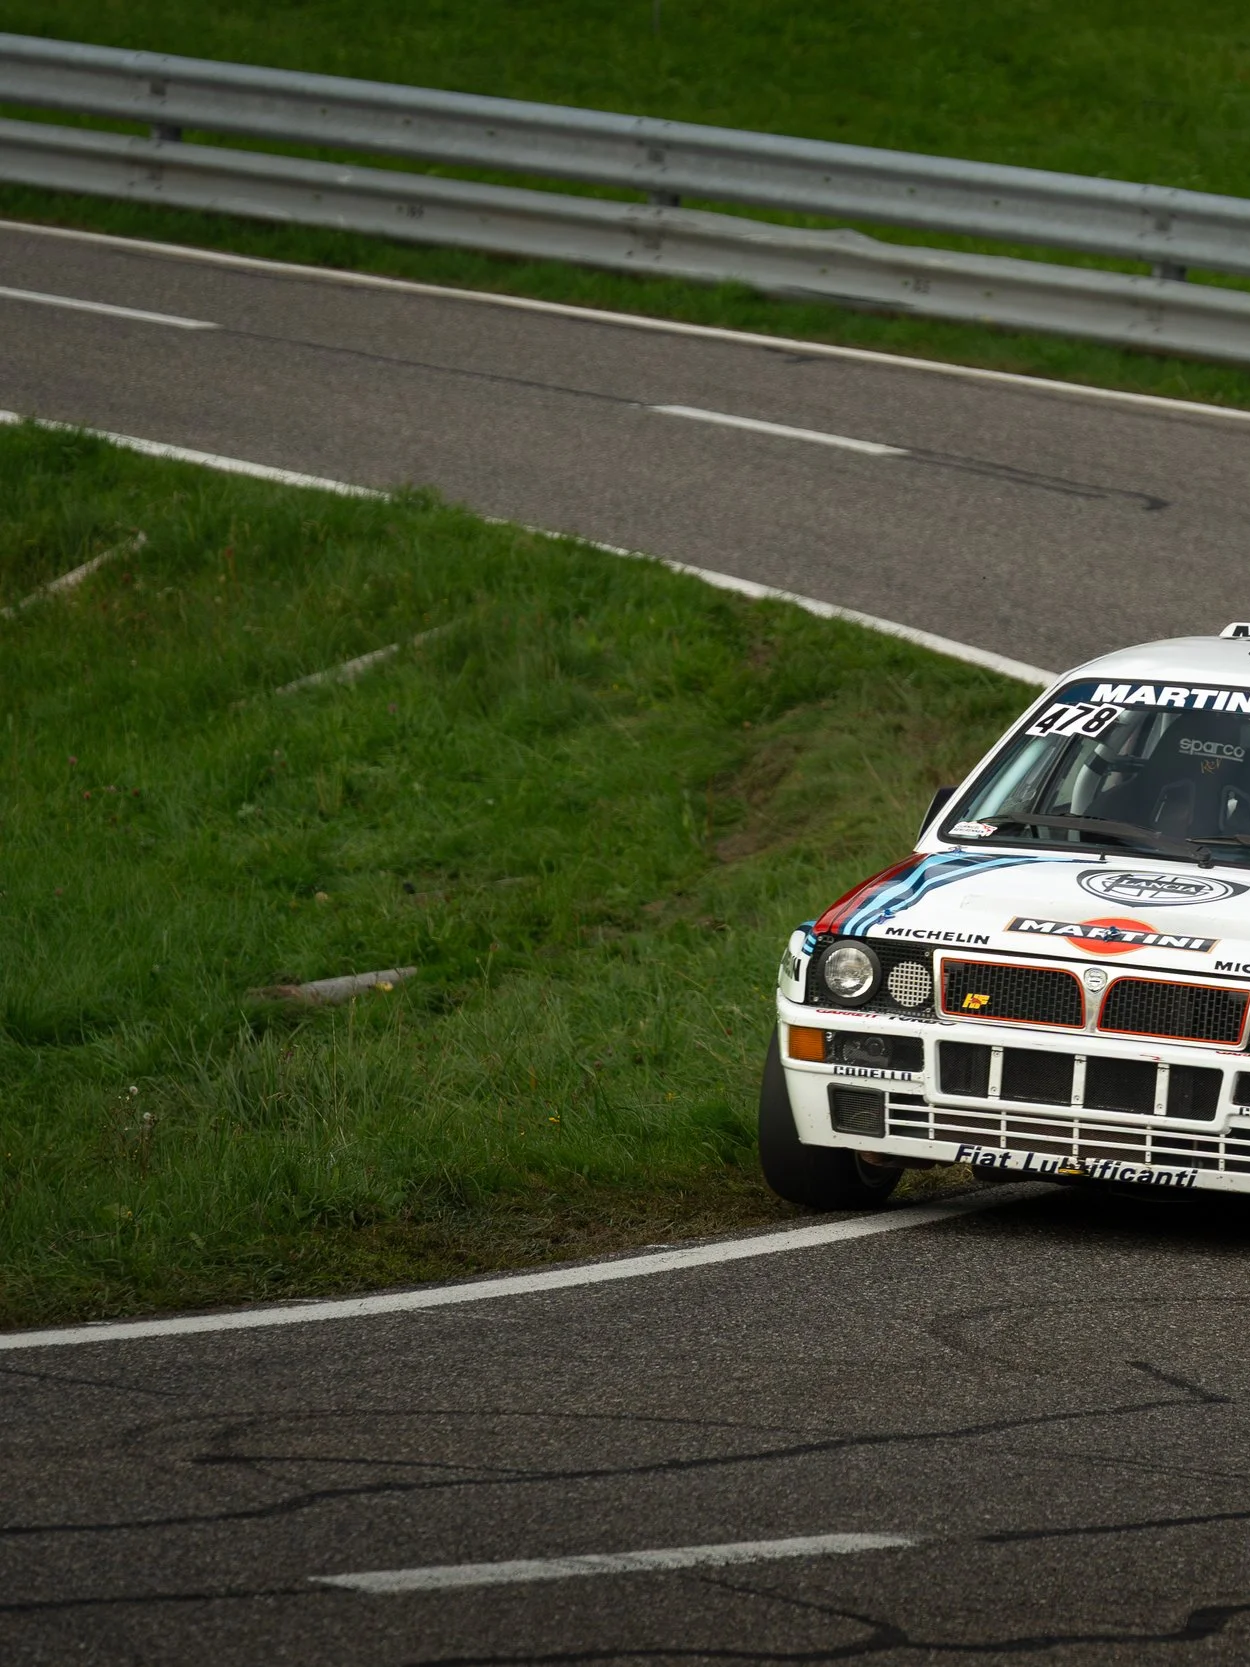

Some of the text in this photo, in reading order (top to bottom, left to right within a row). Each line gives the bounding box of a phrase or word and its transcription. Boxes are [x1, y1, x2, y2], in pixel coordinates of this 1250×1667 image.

[1035, 703, 1118, 734] 478
[1179, 737, 1246, 760] sparco
[1119, 879, 1198, 894] LANCIA
[885, 927, 990, 945] MICHELIN
[1017, 919, 1208, 951] MARTINI
[962, 993, 990, 1009] HF
[954, 1143, 1011, 1169] Fiat
